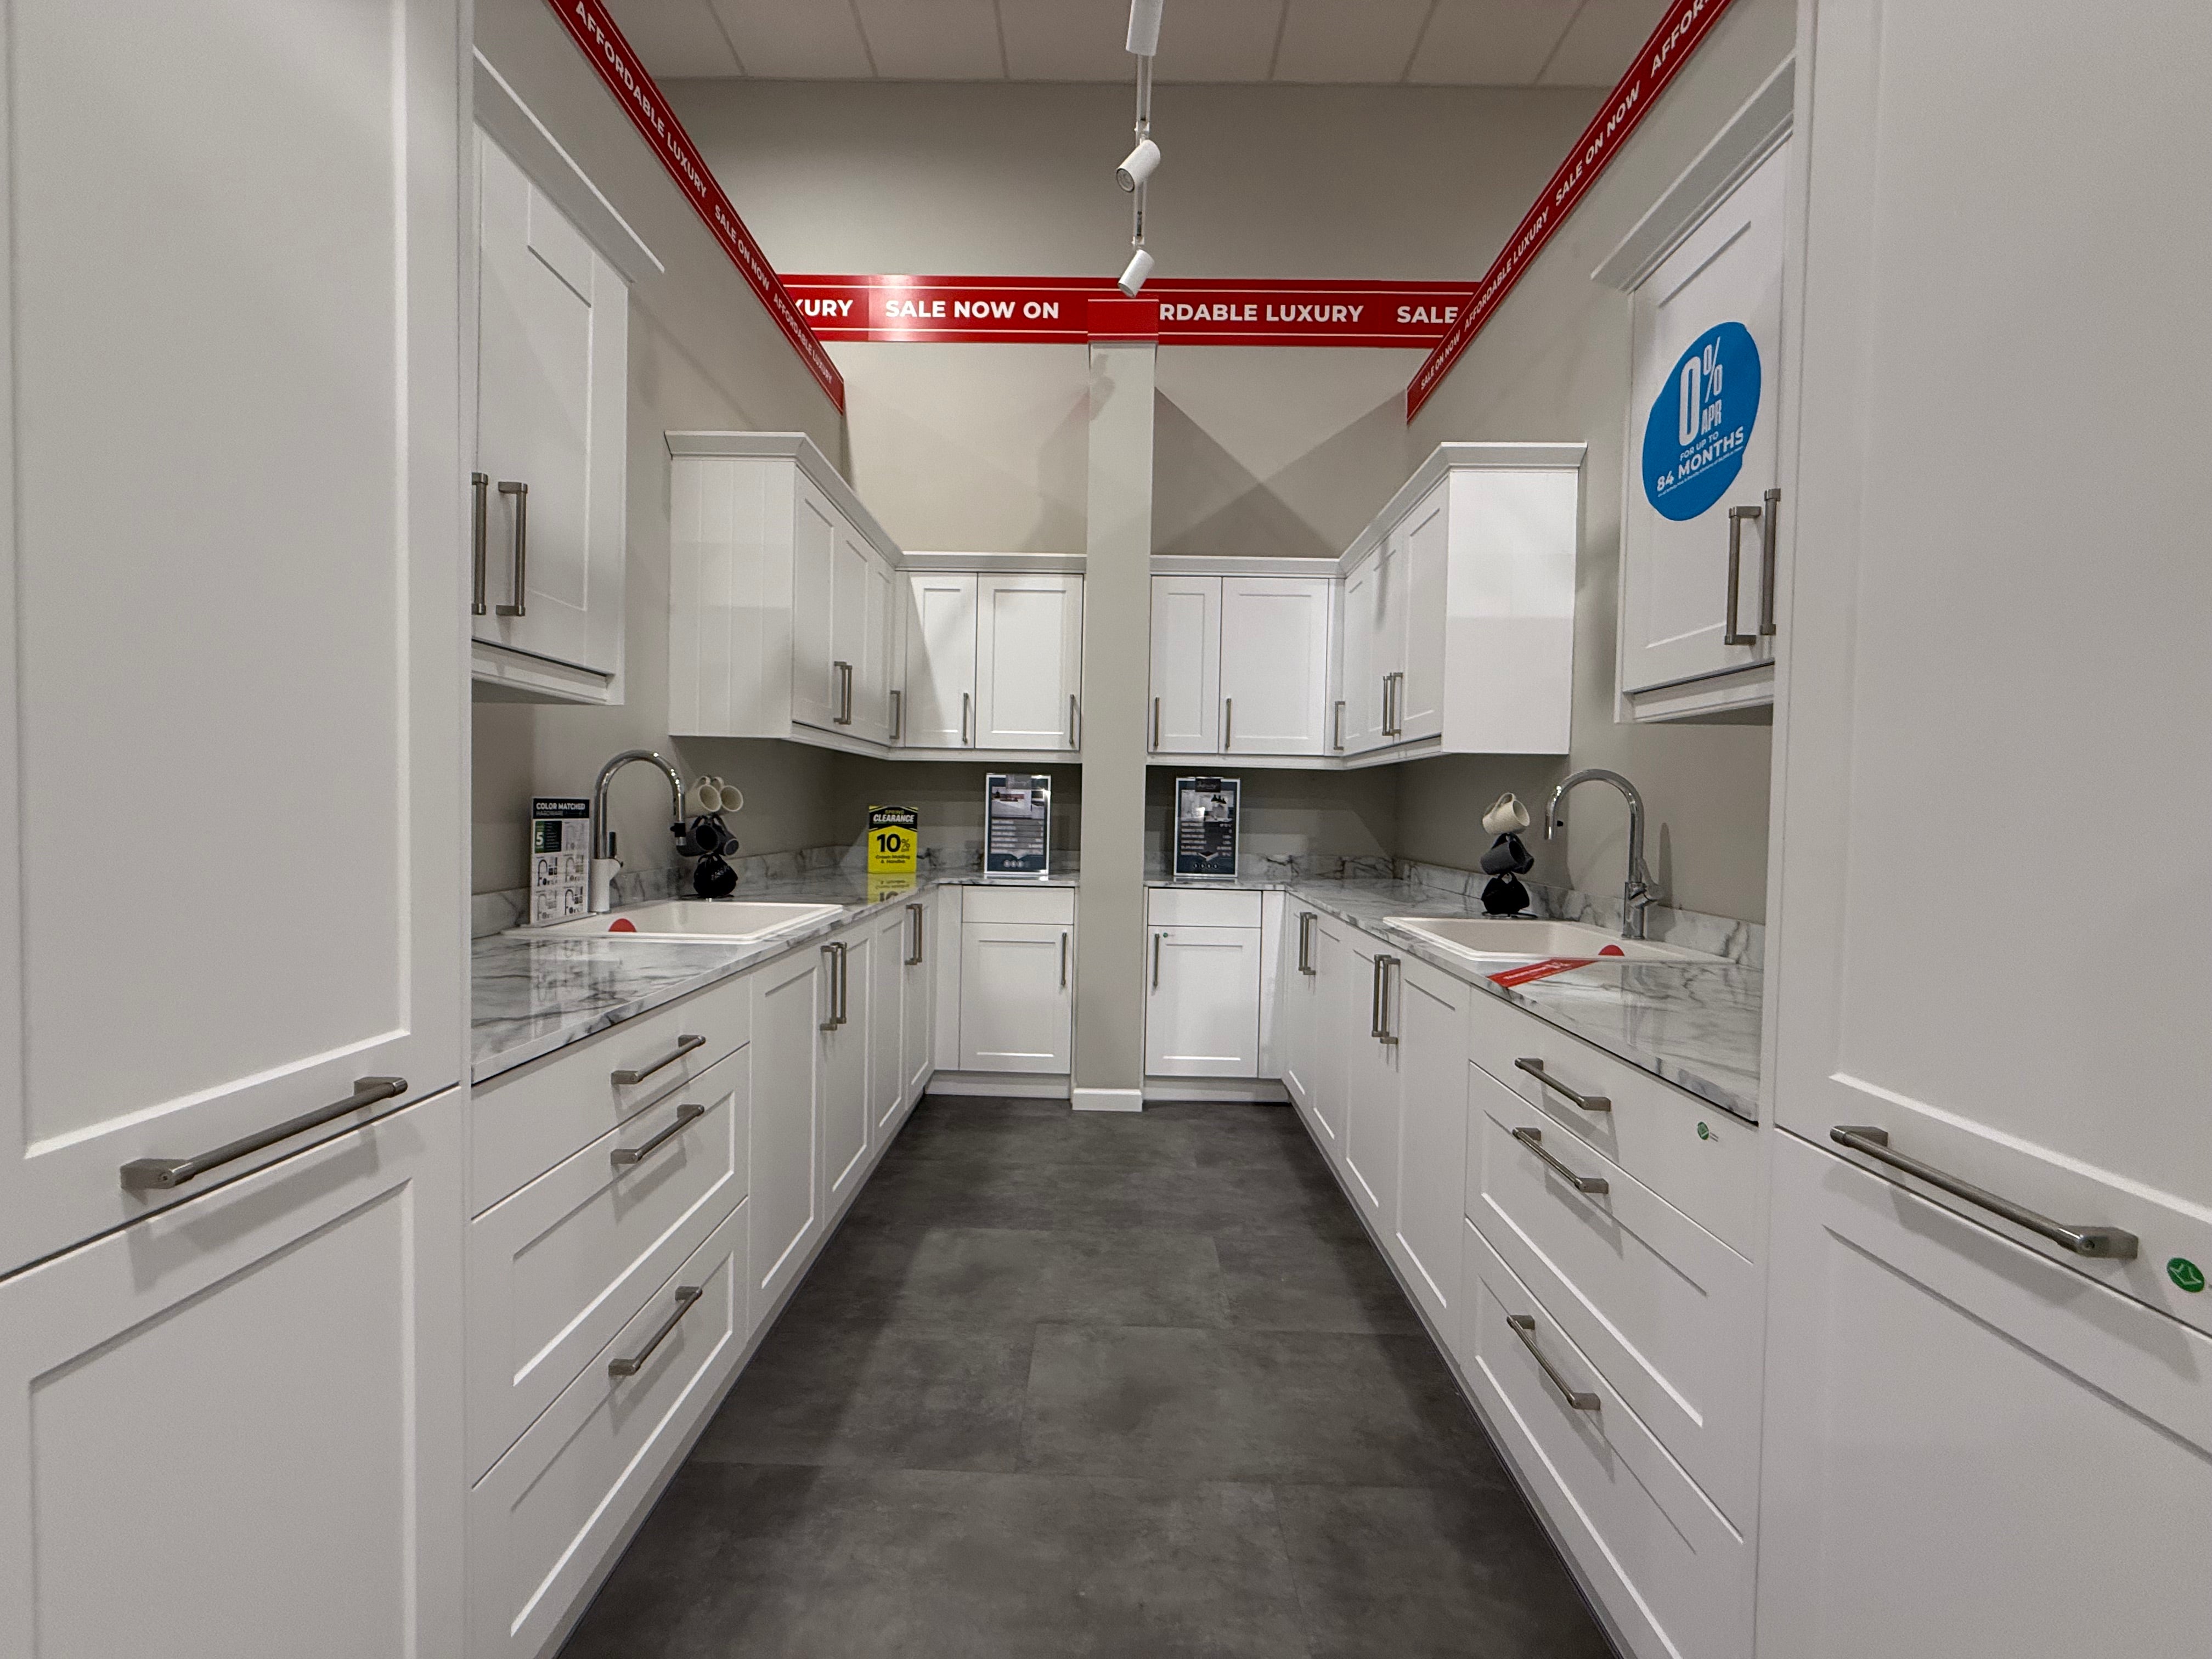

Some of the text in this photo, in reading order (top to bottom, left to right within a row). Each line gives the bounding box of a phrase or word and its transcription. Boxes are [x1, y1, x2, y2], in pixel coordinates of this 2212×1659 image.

[576, 1, 664, 137] AFFORDABLE
[667, 132, 706, 198] LUXURY
[715, 205, 737, 244] SALE
[738, 239, 750, 263] ON
[751, 258, 770, 291] NOW
[774, 293, 812, 356] AFFORDABLE
[1421, 0, 1708, 390] SALE ON NOW AFFORDABLE LUXURY SALE ON NOW AFFOR
[885, 300, 946, 318] SALE
[954, 301, 1015, 319] NOW
[1024, 302, 1059, 319] ON
[1159, 304, 1258, 321] RDABLE
[1266, 305, 1364, 323] LUXURY
[1397, 306, 1459, 324] SALE
[1701, 399, 1722, 435] APR
[1657, 471, 1674, 492] 84
[1678, 426, 1743, 479] MONTHS
[1680, 431, 1719, 461] FOR UP TO
[873, 814, 915, 822] CLEARANCE
[536, 831, 544, 845] 5
